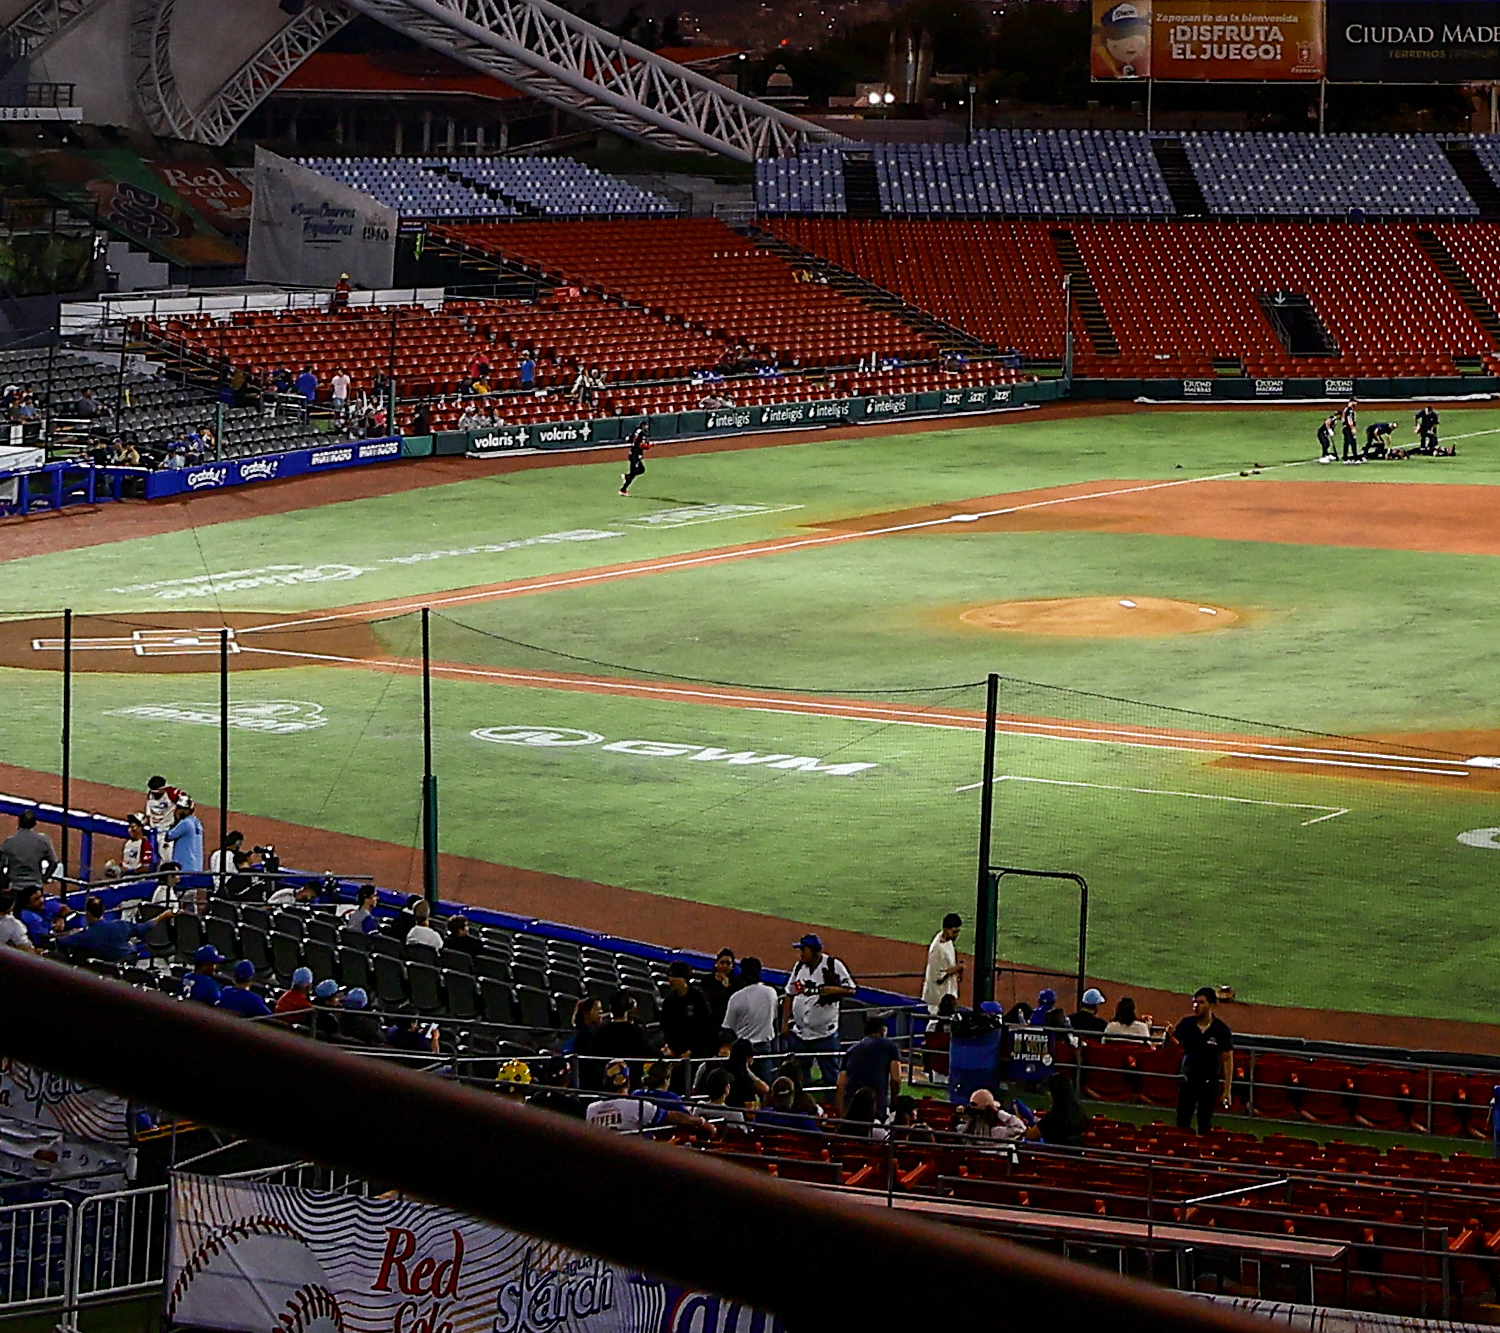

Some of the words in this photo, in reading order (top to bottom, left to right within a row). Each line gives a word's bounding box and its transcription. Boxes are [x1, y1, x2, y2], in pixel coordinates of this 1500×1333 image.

[1156, 14, 1201, 25] Zapopan
[1202, 14, 1213, 23] te
[1214, 13, 1228, 23] da
[1241, 13, 1299, 24] bienvenida
[1169, 25, 1285, 45] ¡DISFRUTA
[1345, 23, 1435, 44] CIUDAD
[1171, 44, 1197, 60] EL
[1199, 44, 1283, 60] JUEGO!
[161, 167, 230, 190] Red
[195, 187, 242, 200] Cola
[109, 181, 180, 239] aga
[769, 405, 804, 422] inteligis
[816, 401, 851, 418] inteligis
[874, 397, 908, 414] inteligis
[715, 411, 751, 428] inteligis
[474, 431, 514, 449] volaris
[539, 425, 578, 443] volaris
[188, 467, 221, 487] Grateful
[602, 739, 879, 776] GWM
[370, 1226, 466, 1302] Red
